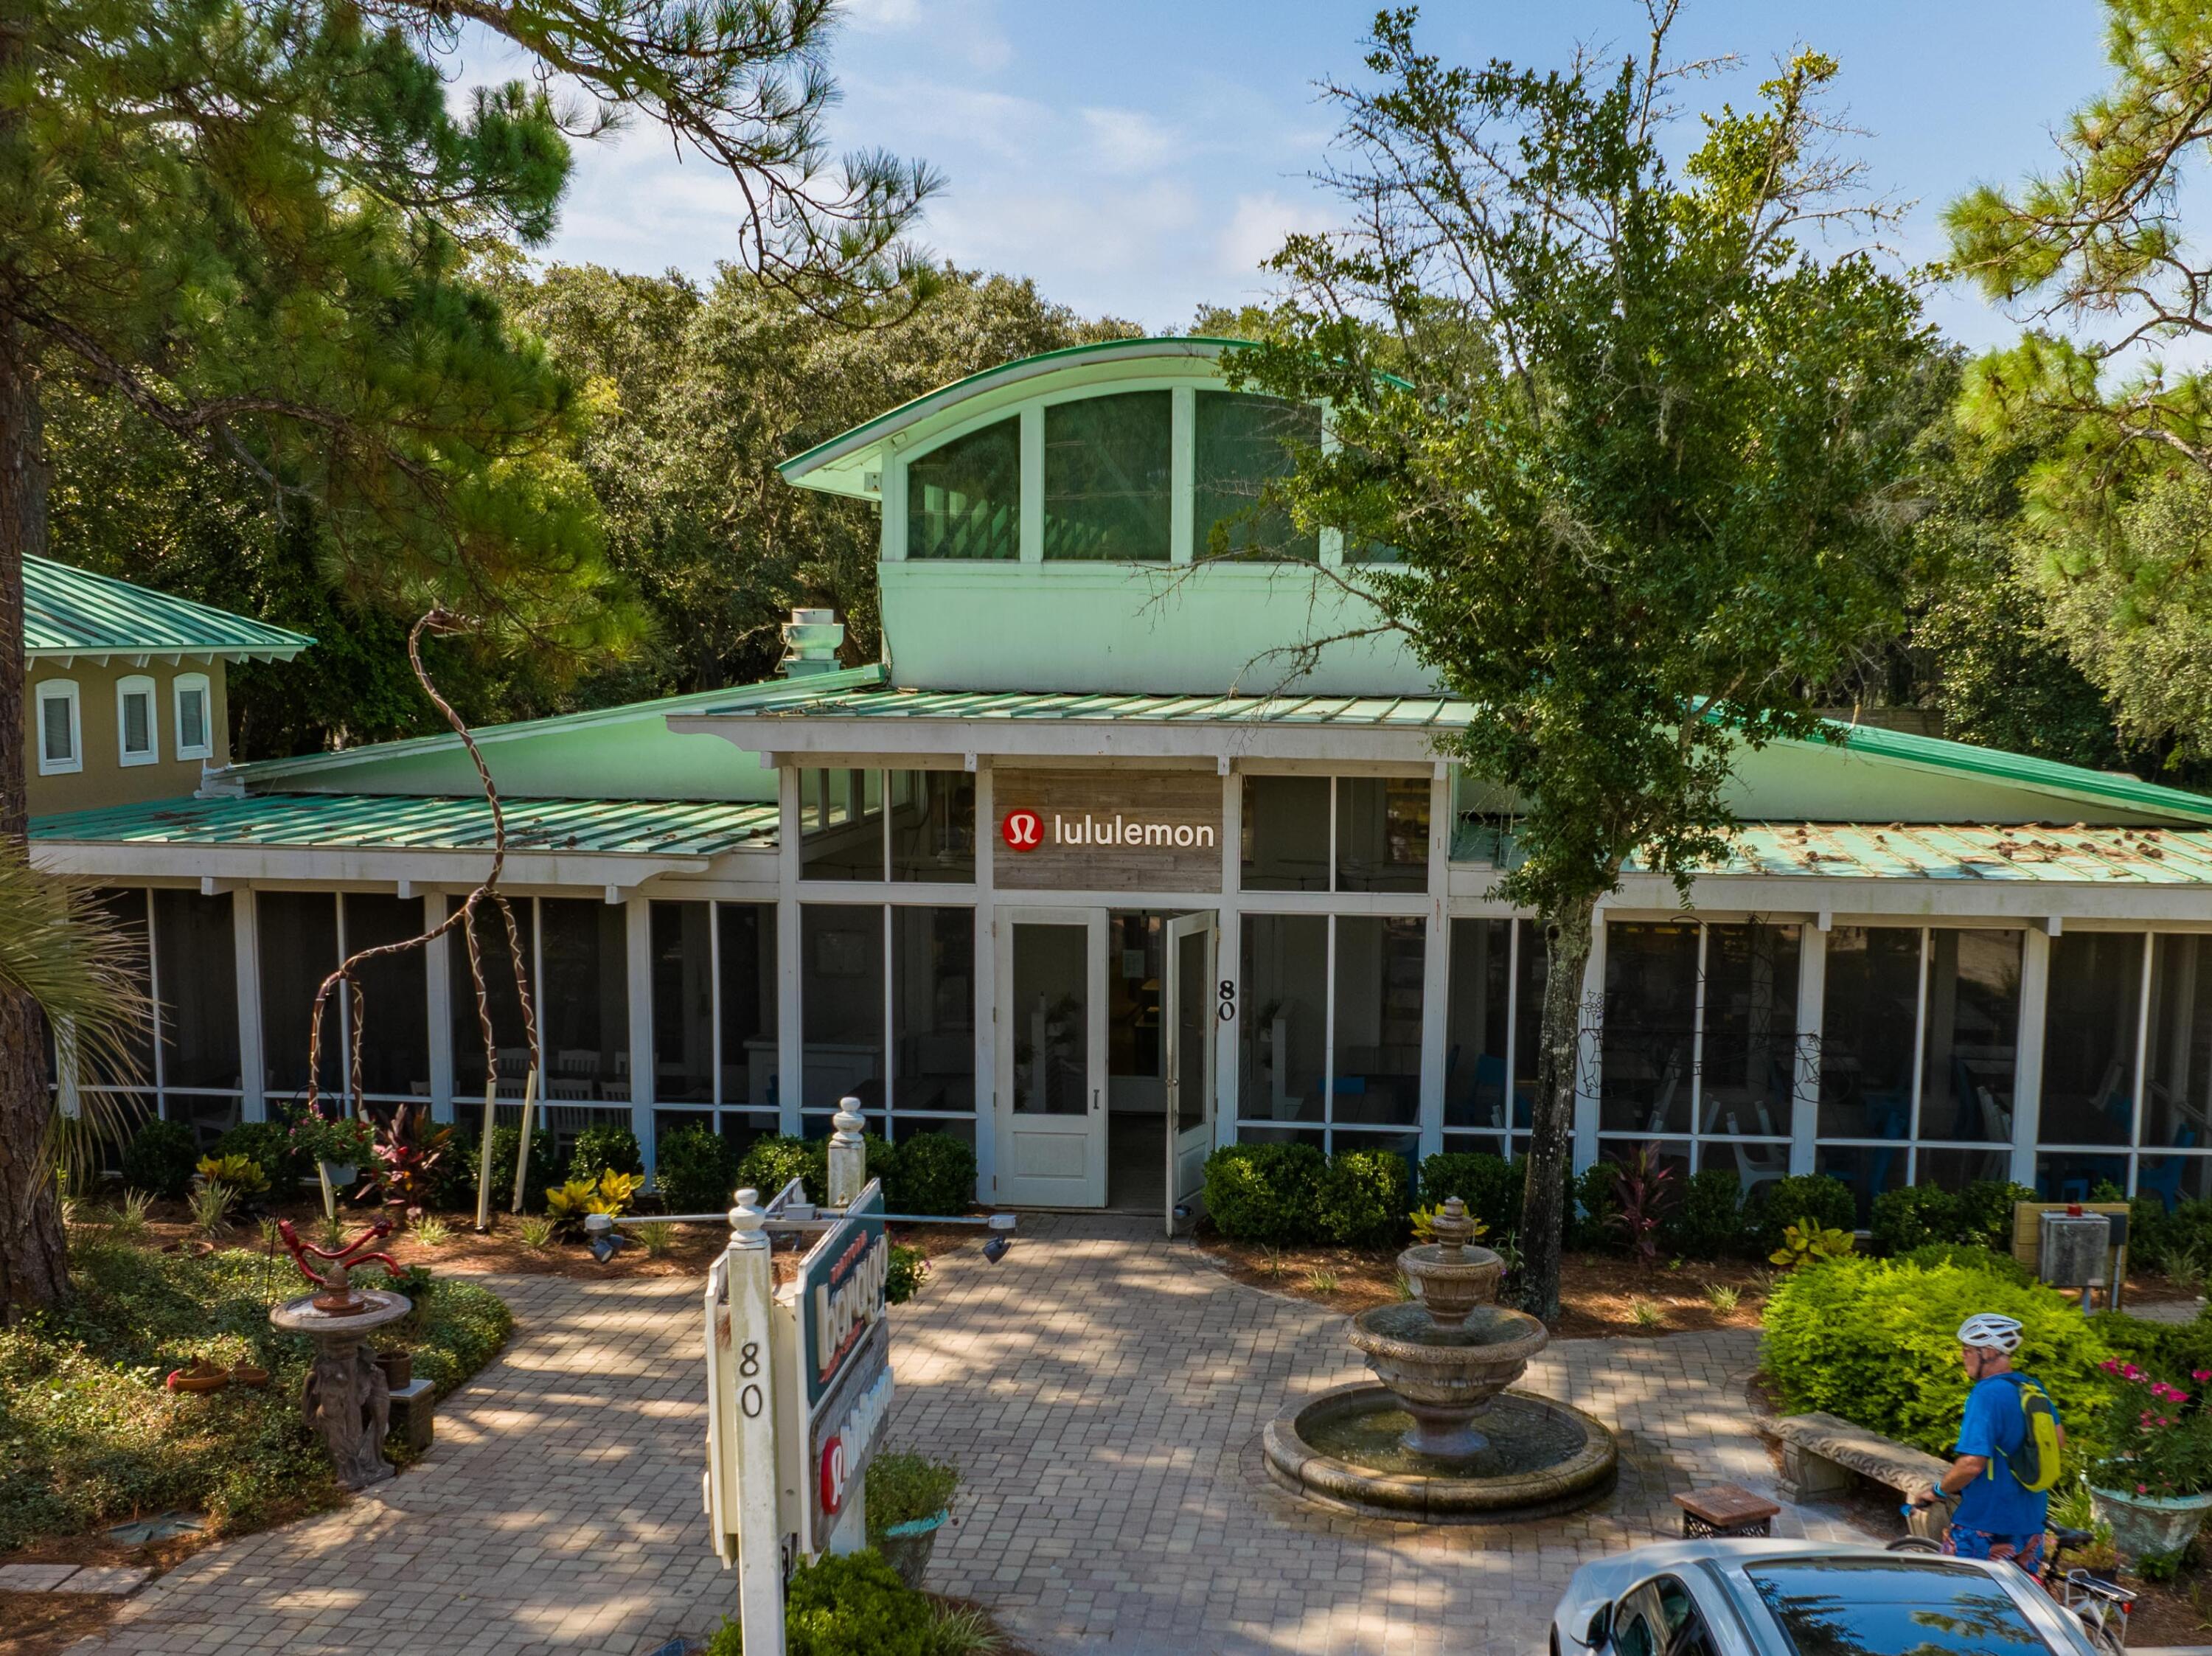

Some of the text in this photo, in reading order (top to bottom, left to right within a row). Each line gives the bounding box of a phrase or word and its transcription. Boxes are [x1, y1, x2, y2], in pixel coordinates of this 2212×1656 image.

[1055, 814, 1214, 847] lululemon
[1219, 980, 1235, 1021] 80
[815, 1234, 888, 1371] borago
[740, 1342, 762, 1419] 80
